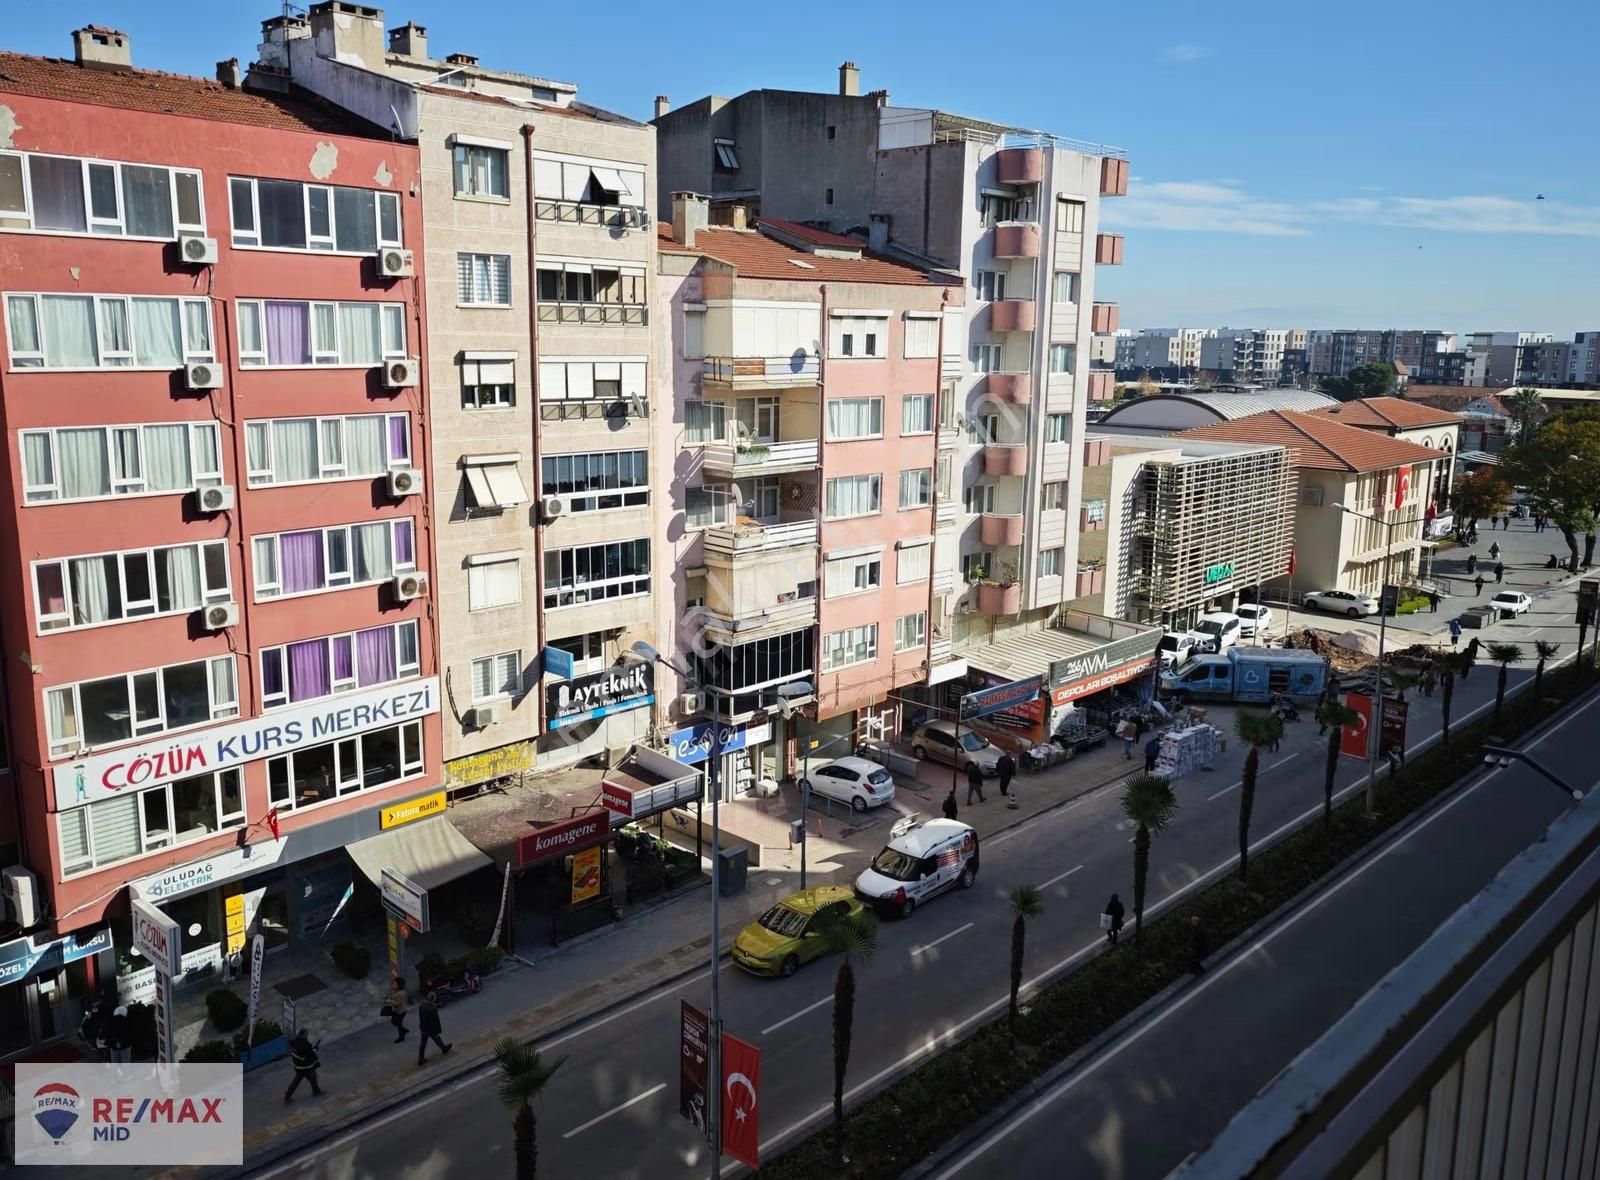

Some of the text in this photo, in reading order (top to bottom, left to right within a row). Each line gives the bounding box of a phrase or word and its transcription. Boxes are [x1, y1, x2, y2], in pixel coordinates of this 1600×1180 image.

[1079, 651, 1108, 678] AVM
[1057, 682, 1100, 701] DEPOLARI
[102, 685, 431, 791] ÇÖZÜM KURS MERKEZİ
[396, 800, 439, 820] Faturamatik
[535, 820, 597, 851] komagene
[163, 864, 213, 886] ULUDAĞ
